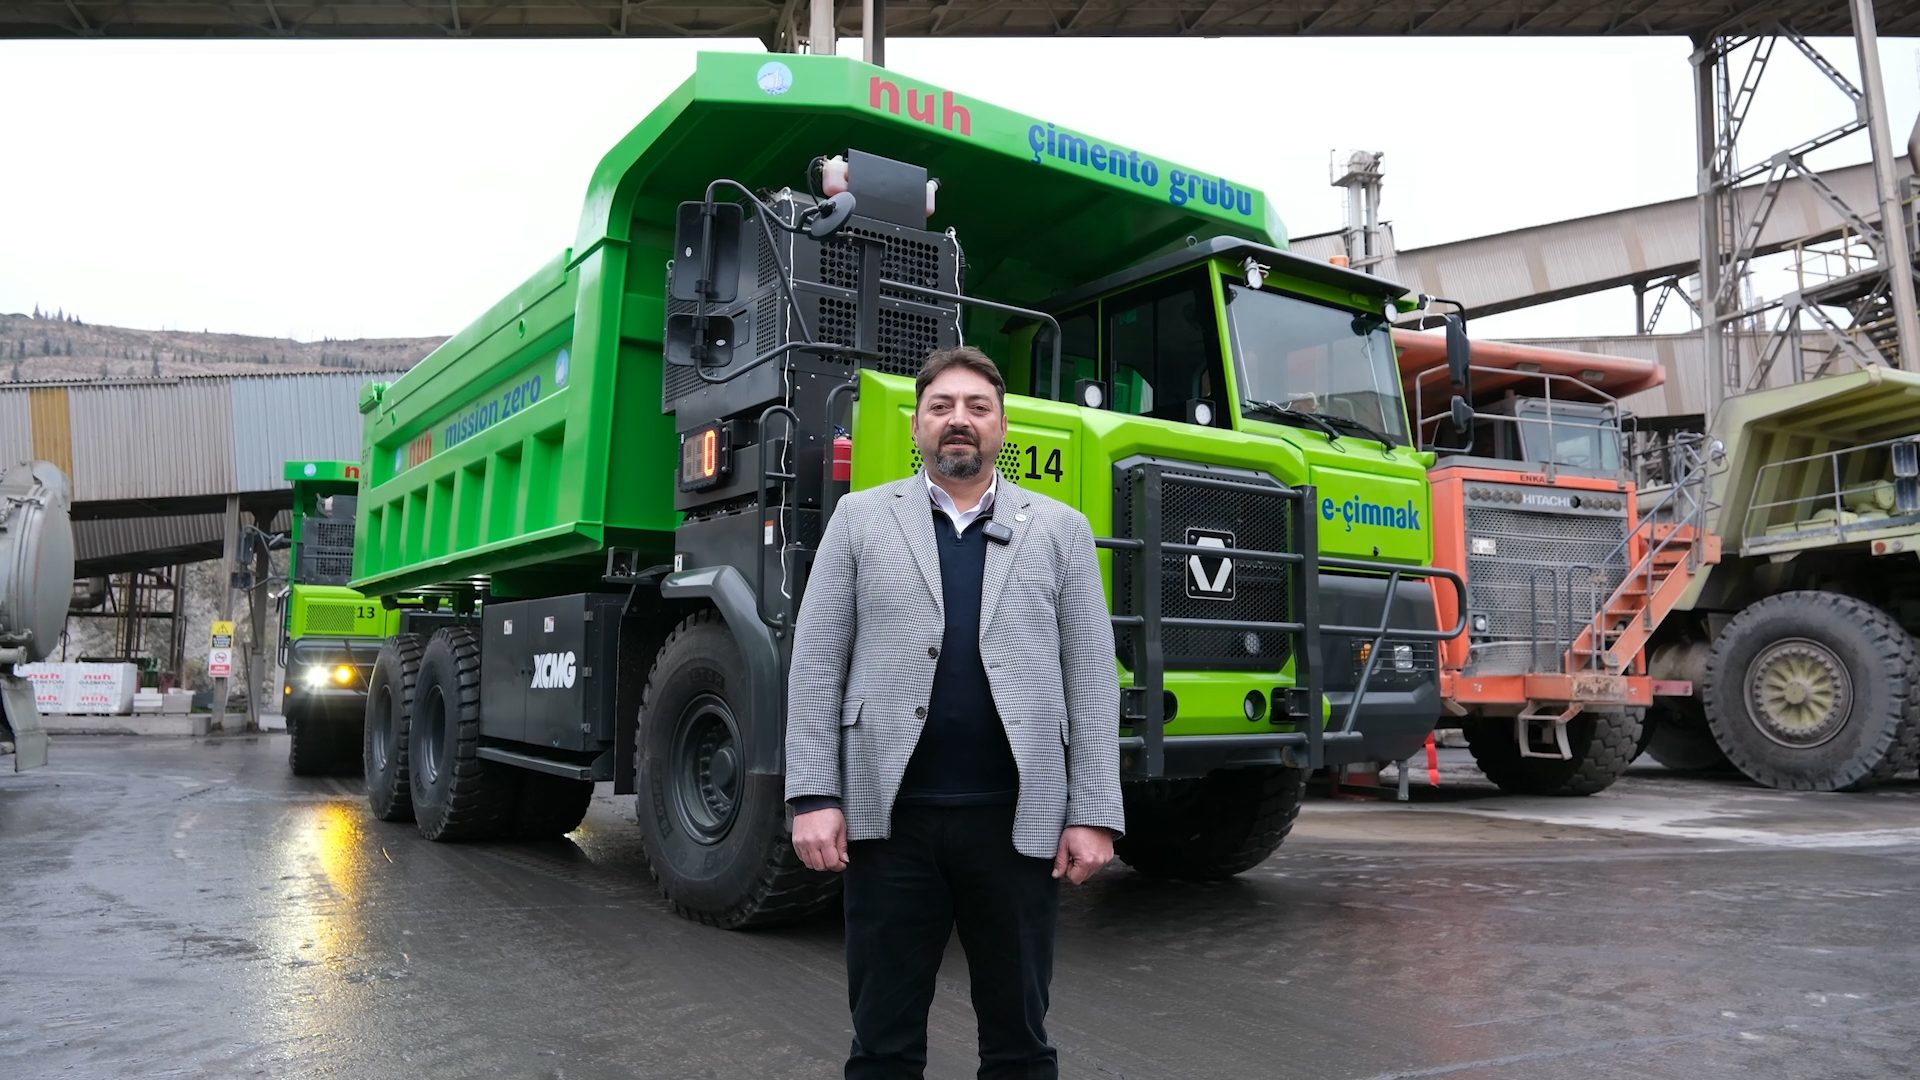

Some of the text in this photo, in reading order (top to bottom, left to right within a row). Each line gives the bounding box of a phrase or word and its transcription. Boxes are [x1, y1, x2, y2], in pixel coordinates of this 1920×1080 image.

[869, 76, 970, 136] nuh
[1028, 122, 1252, 216] çimento grubu
[408, 375, 541, 469] nuh mission zero
[1025, 445, 1063, 483] 14
[1519, 474, 1545, 484] ENKA
[1322, 495, 1420, 532] e-çimnak
[1522, 494, 1570, 507] HITACHI
[357, 606, 375, 619] 13
[530, 651, 576, 688] XCMG
